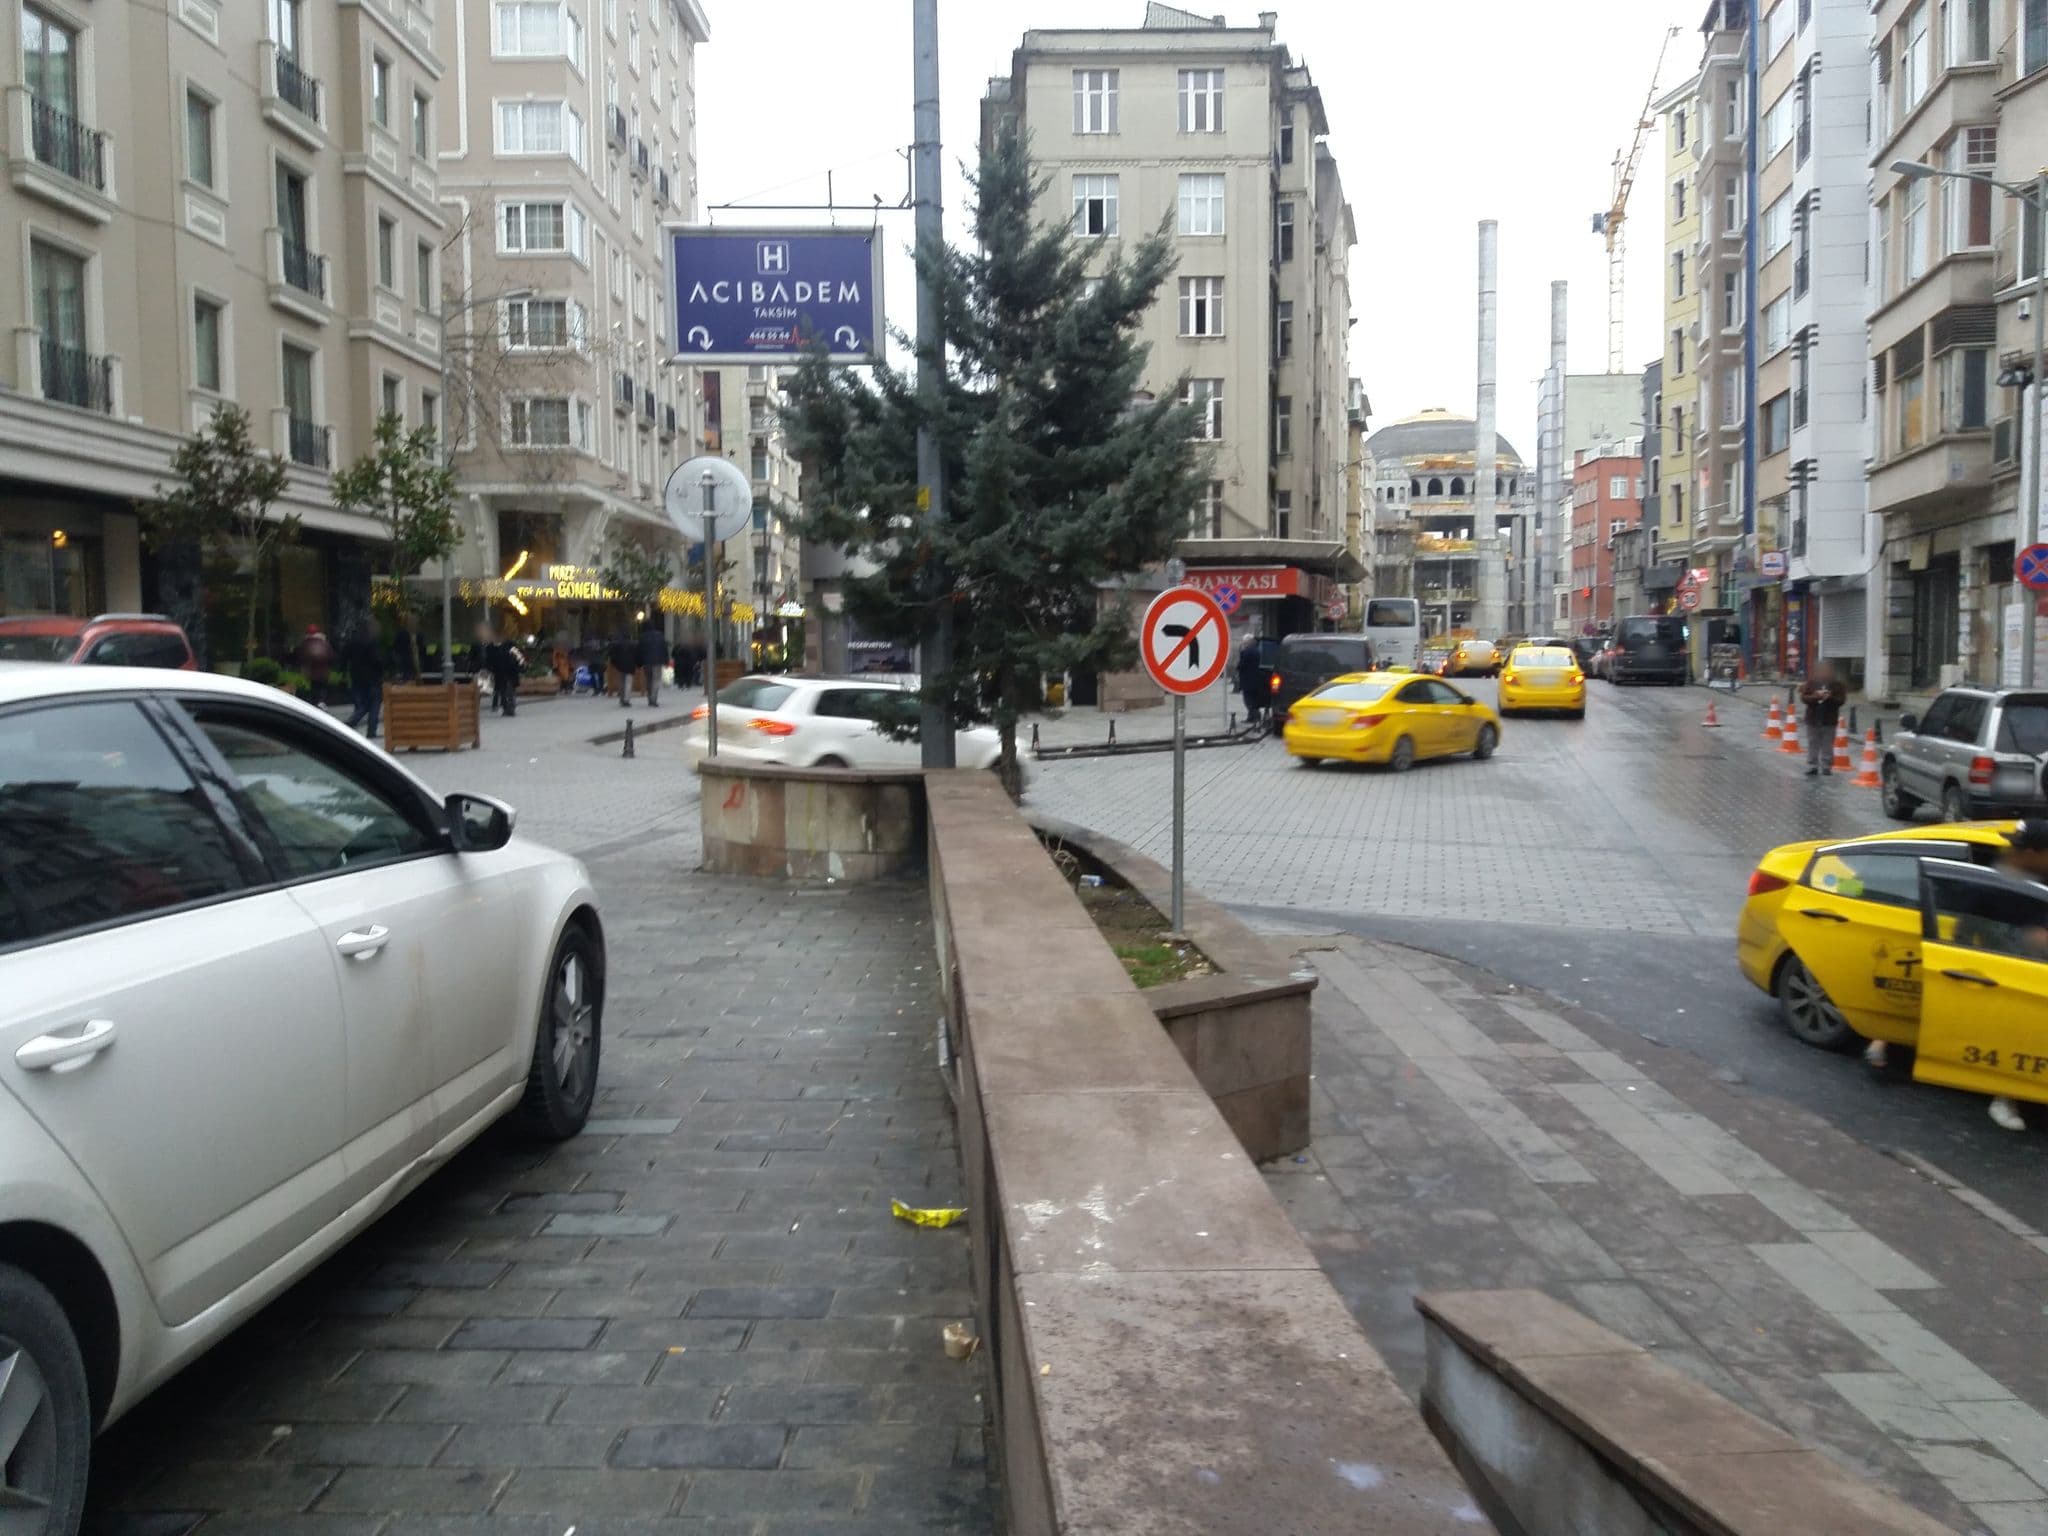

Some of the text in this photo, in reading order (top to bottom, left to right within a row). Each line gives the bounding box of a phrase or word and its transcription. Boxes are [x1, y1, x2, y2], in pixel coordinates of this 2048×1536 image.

[763, 246, 783, 271] H
[689, 280, 860, 304] ACIBADEM
[1190, 575, 1278, 591] BANKASI
[1962, 1045, 2000, 1068] 34
